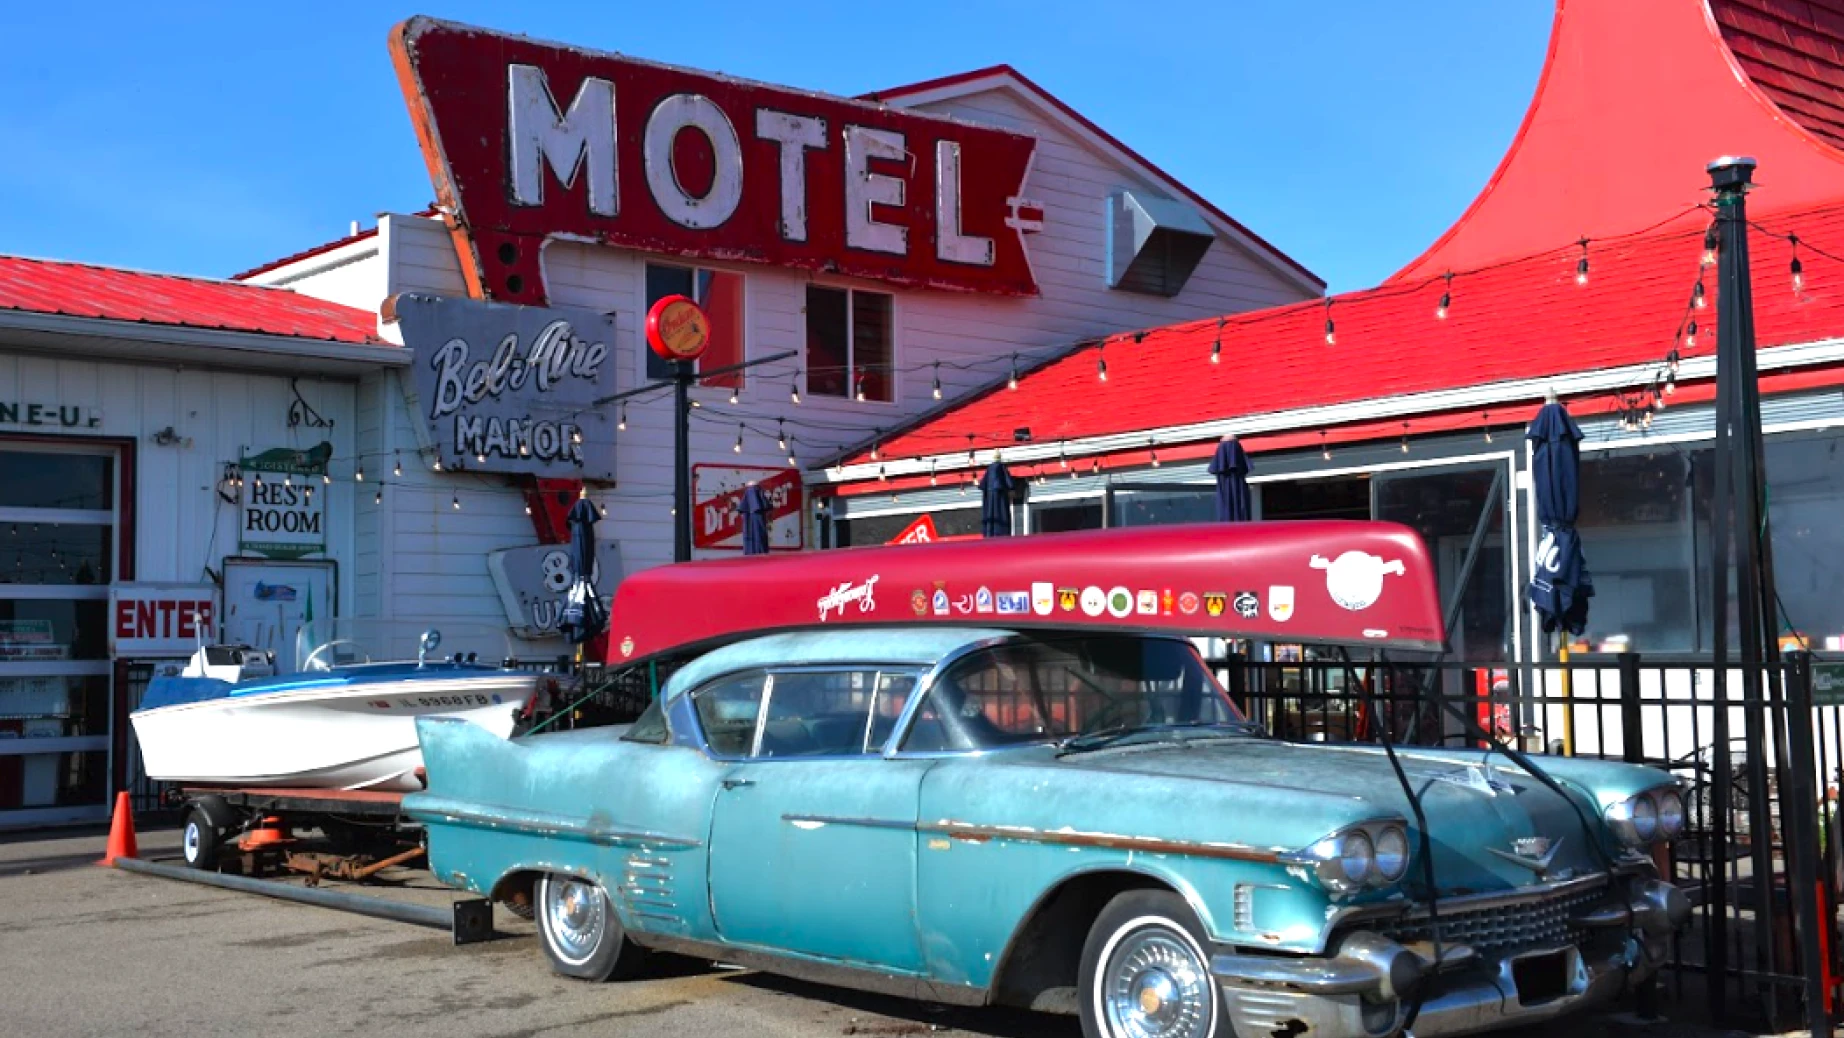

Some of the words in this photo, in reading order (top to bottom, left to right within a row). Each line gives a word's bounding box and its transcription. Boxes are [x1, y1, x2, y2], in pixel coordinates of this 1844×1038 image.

[508, 63, 995, 266] MOTEL
[454, 414, 584, 468] MANOR
[251, 482, 315, 507] REST
[246, 508, 322, 534] ROOM
[116, 599, 216, 638] ENTER
